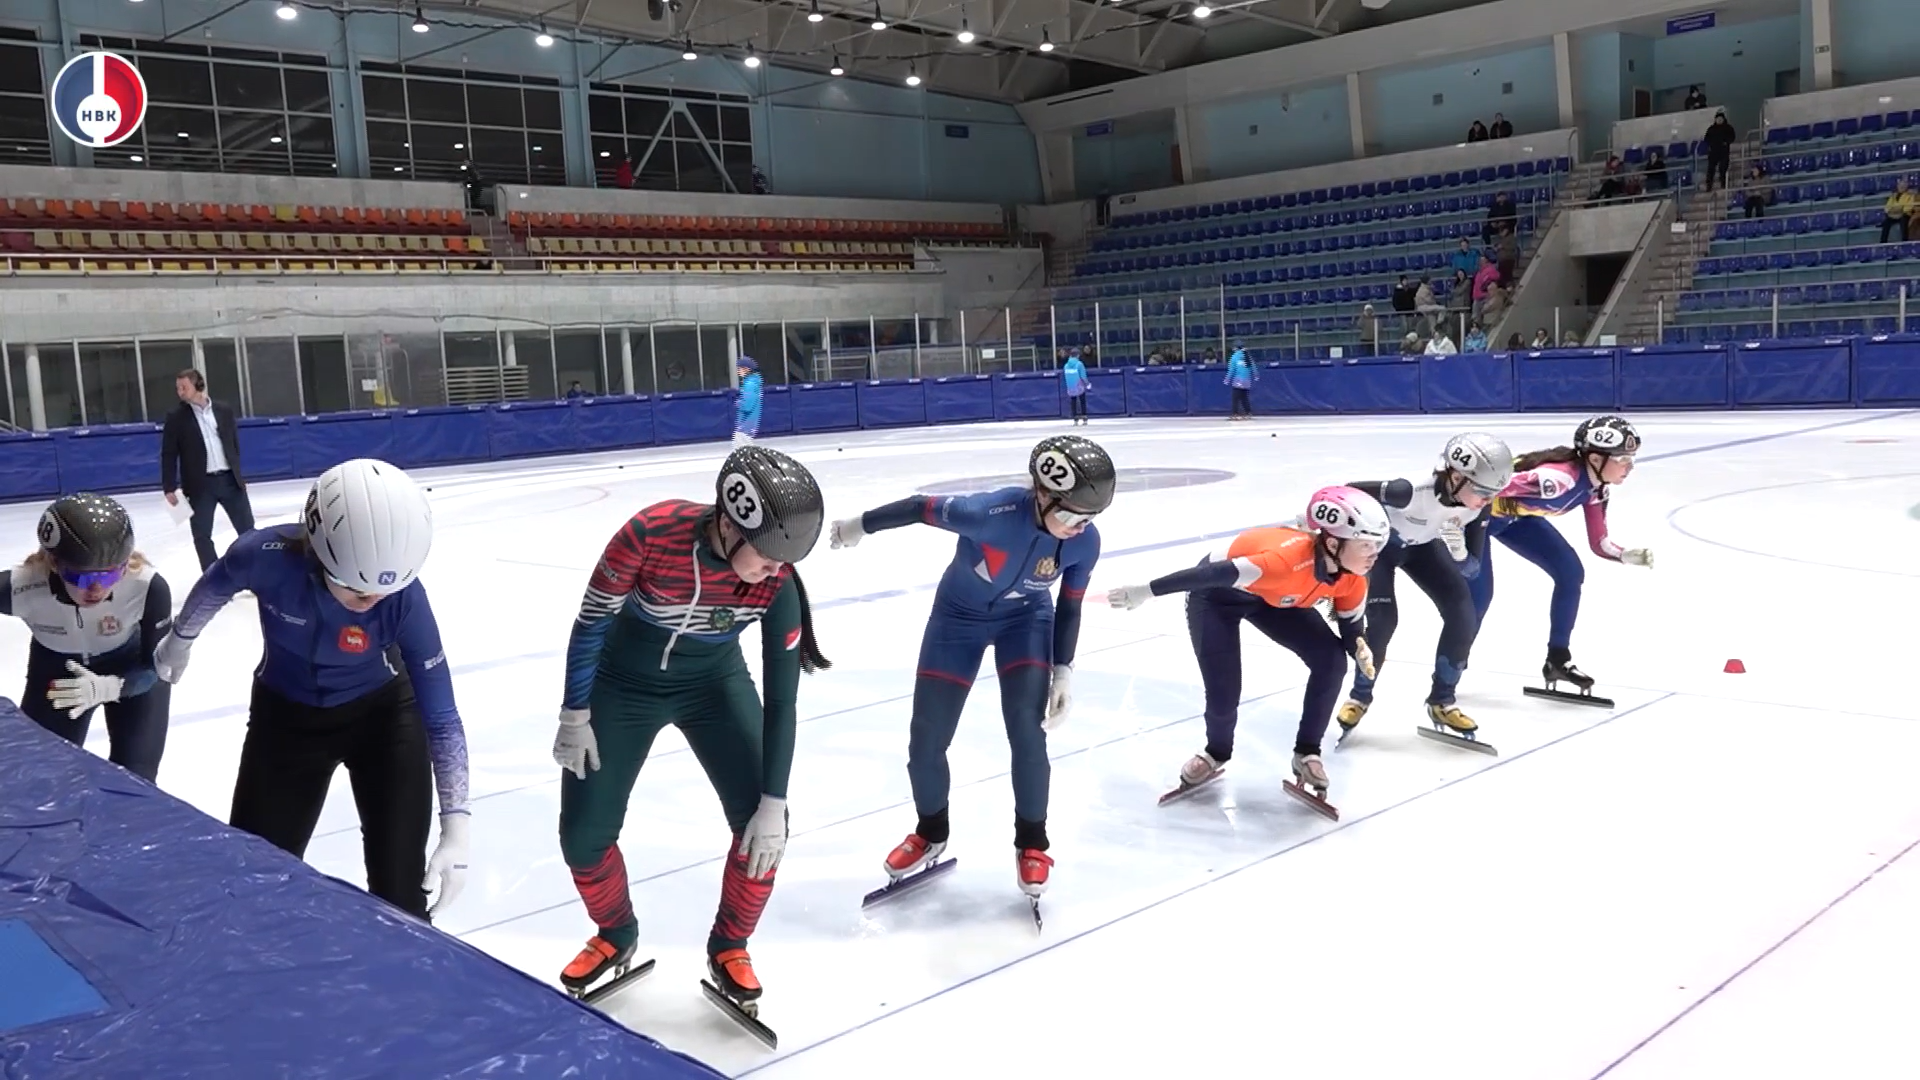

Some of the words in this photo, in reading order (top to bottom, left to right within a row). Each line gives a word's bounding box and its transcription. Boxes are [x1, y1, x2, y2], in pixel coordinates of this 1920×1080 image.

[1594, 430, 1614, 444] 62
[1451, 446, 1472, 467] 84
[1040, 456, 1068, 487] 82
[727, 481, 756, 521] 83
[1315, 504, 1339, 524] 86
